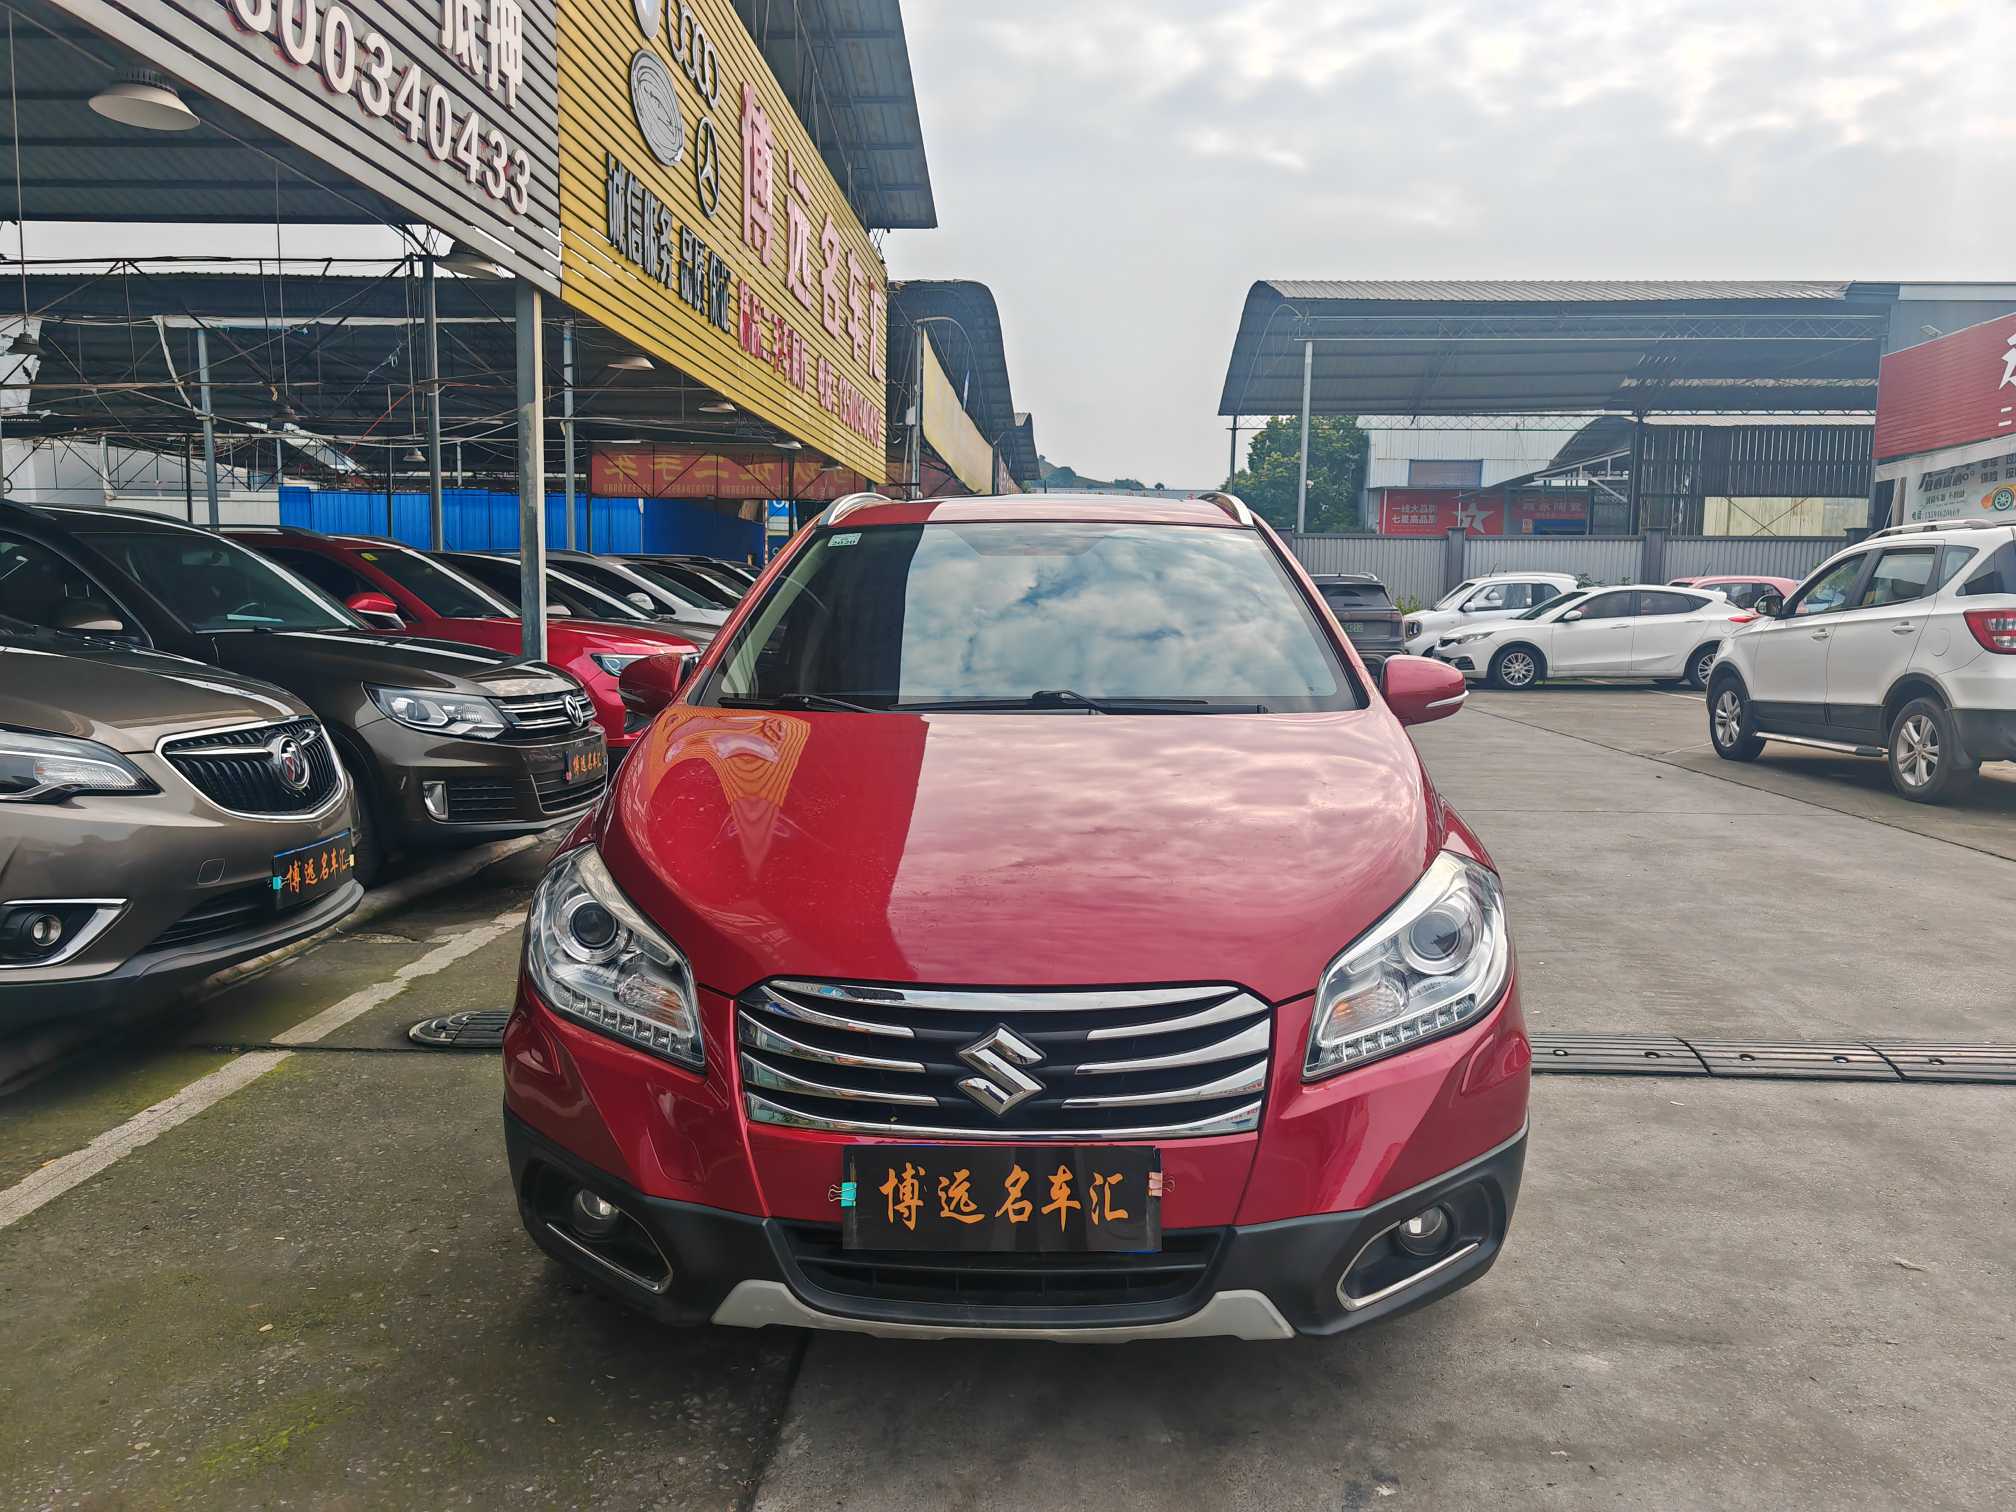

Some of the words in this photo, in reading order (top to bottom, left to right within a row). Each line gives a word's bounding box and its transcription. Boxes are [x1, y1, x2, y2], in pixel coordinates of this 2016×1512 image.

[606, 151, 673, 289] 诚信服务
[741, 81, 882, 381] 博远名车汇
[287, 847, 349, 894] 博远名车汇
[879, 1162, 1130, 1233] 博远名车汇
